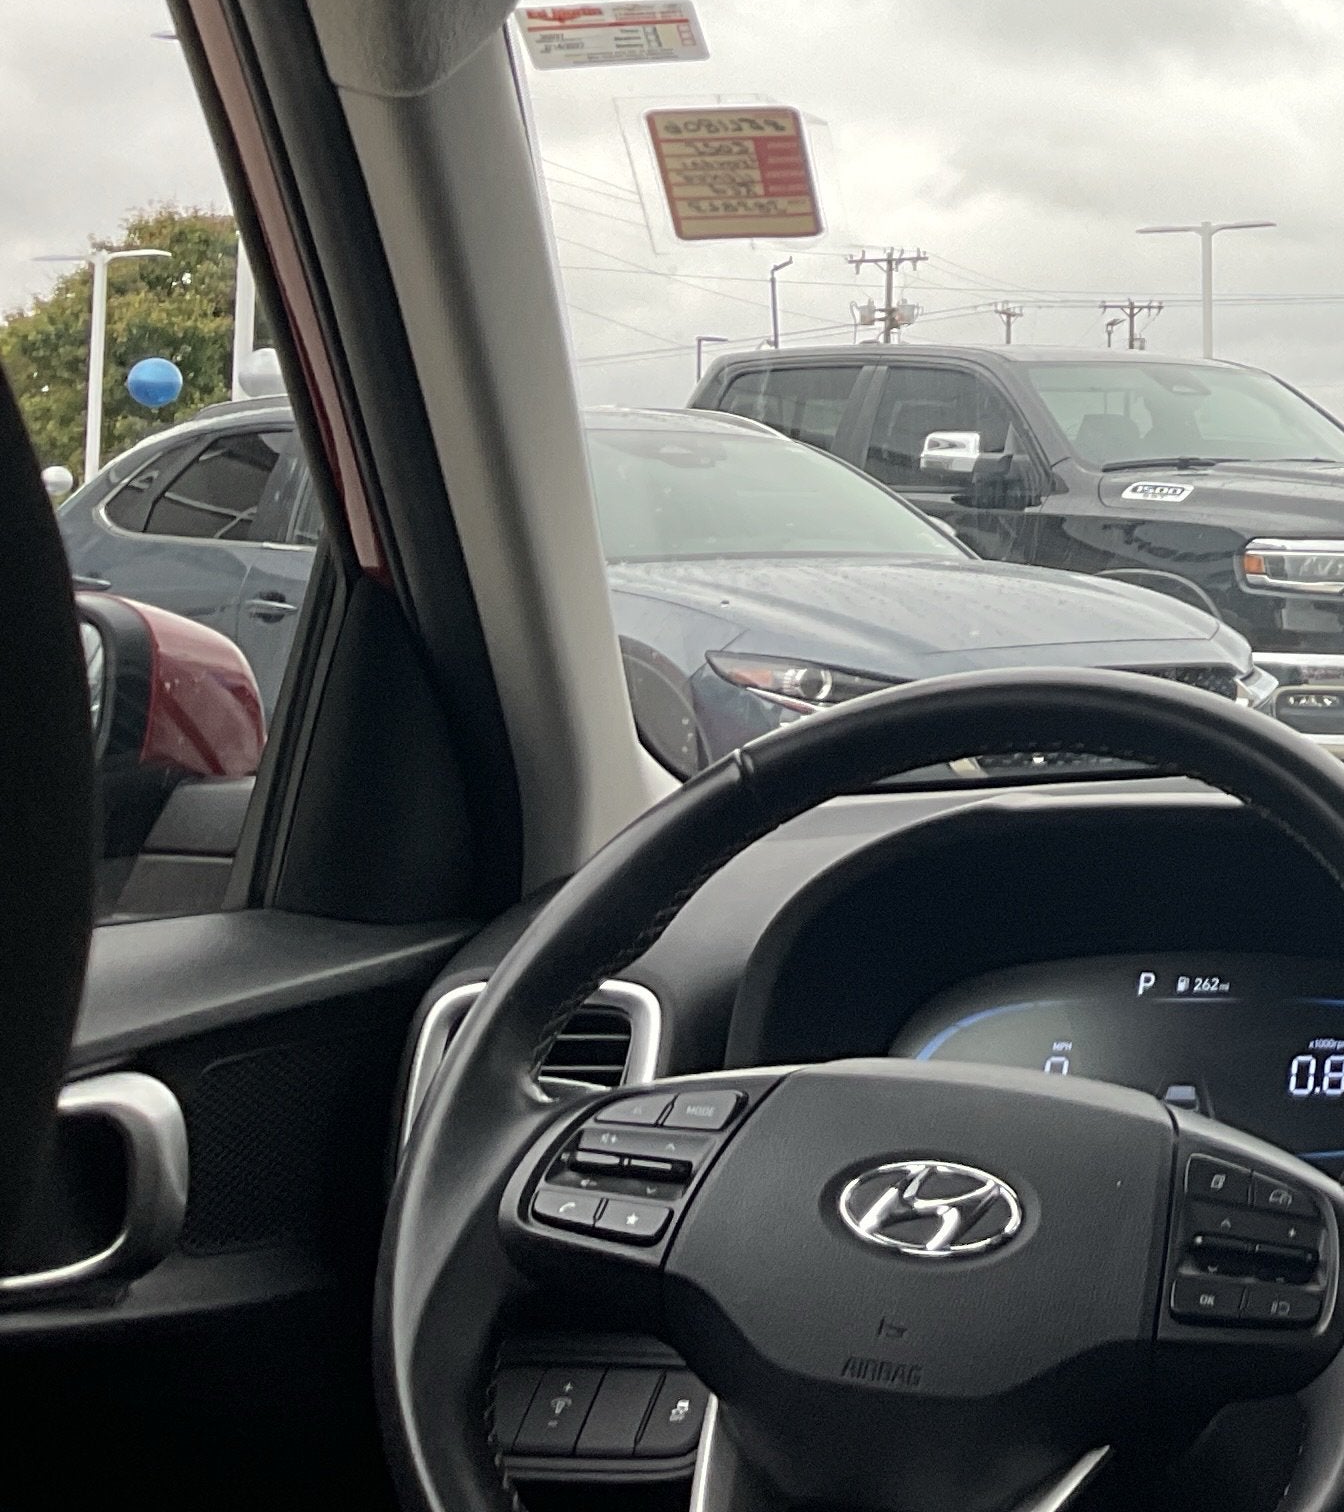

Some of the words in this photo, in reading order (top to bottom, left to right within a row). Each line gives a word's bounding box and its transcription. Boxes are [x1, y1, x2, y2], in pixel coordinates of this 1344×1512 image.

[1134, 485, 1183, 495] 1500
[1137, 971, 1156, 995] P
[1052, 1041, 1073, 1051] MPH
[1199, 1293, 1215, 1306] OK
[840, 1356, 922, 1386] AIRBAG
